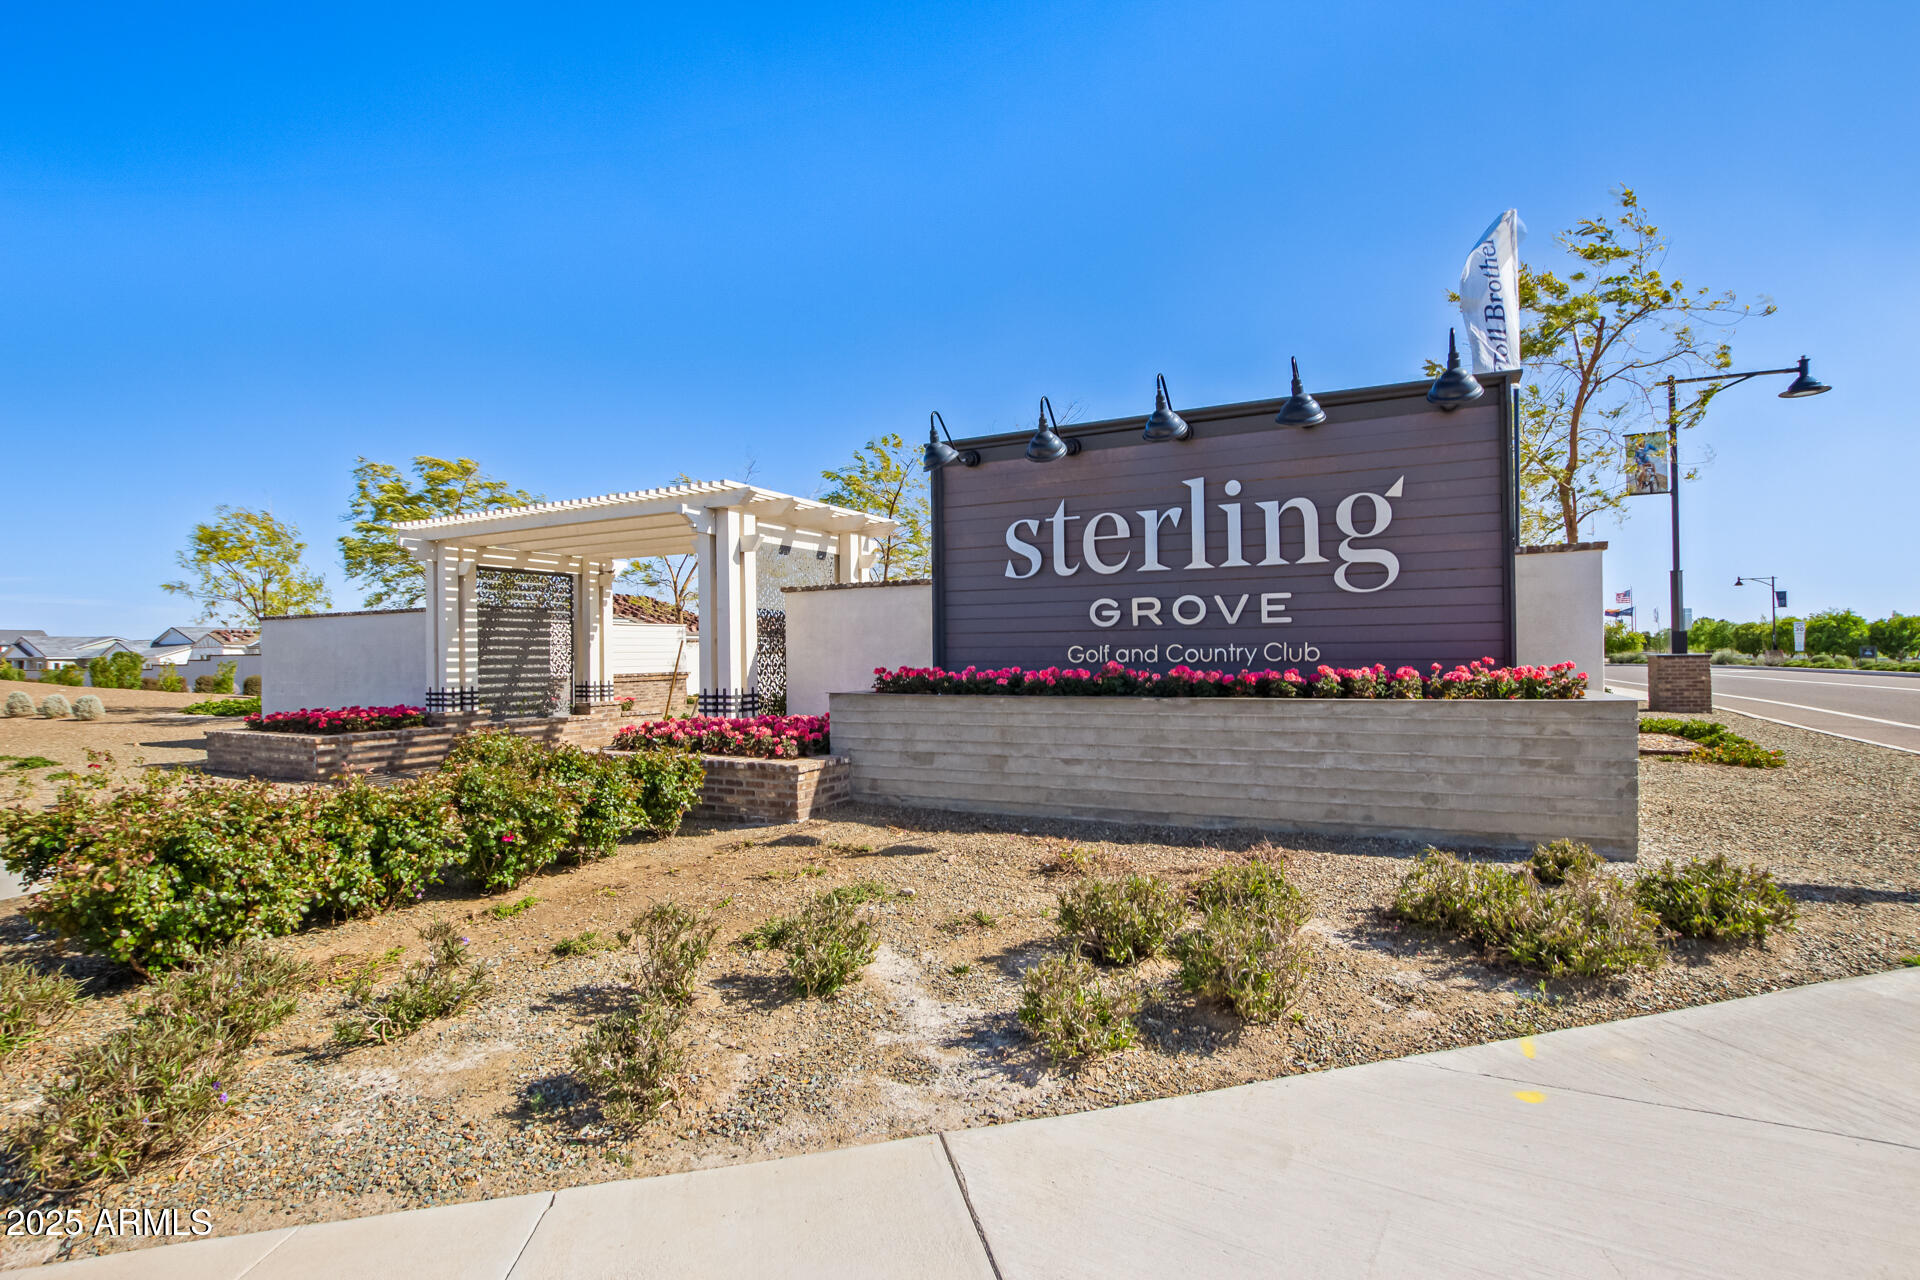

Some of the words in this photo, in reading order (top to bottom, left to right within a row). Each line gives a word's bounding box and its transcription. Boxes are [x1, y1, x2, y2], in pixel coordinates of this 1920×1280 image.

[1004, 474, 1405, 593] sterling
[1089, 592, 1293, 628] GROVE
[1067, 644, 1110, 664] Golf
[1115, 644, 1158, 663] and
[1166, 642, 1258, 666] Country
[1263, 641, 1321, 663] Club
